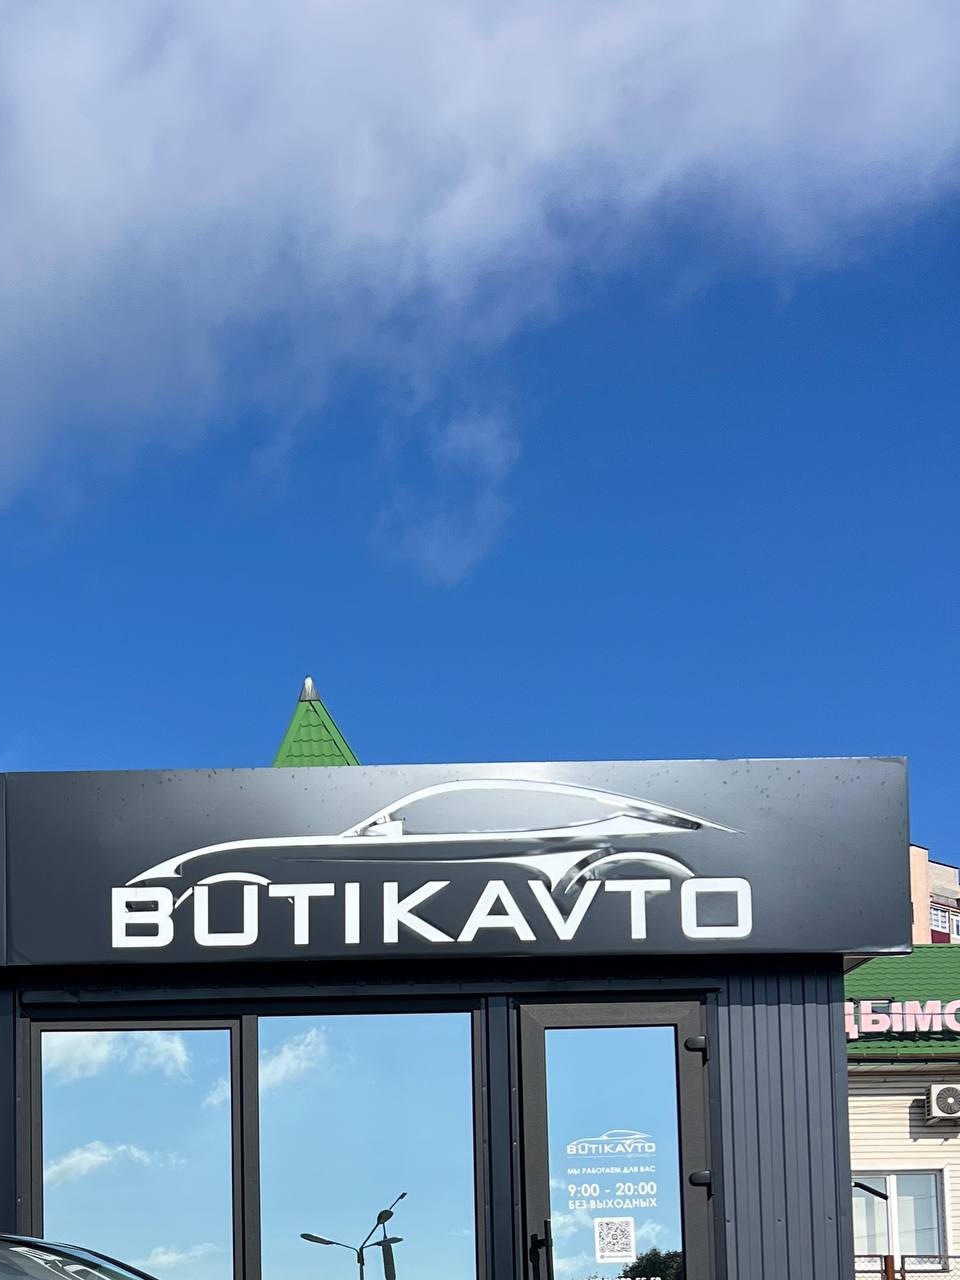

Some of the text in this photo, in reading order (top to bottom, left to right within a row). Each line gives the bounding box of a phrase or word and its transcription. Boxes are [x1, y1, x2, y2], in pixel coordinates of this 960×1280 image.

[111, 876, 754, 949] BUTIKAVTO
[566, 1142, 656, 1154] BUTIKAVTO
[582, 1166, 621, 1175] РАБОТАЕМ
[622, 1166, 638, 1174] ДЛЯ
[640, 1165, 656, 1173] ВАС
[568, 1183, 600, 1197] 9:00
[615, 1181, 657, 1196] 20:00
[568, 1198, 657, 1210] БЕЗ ВЫХОДНЫХ
